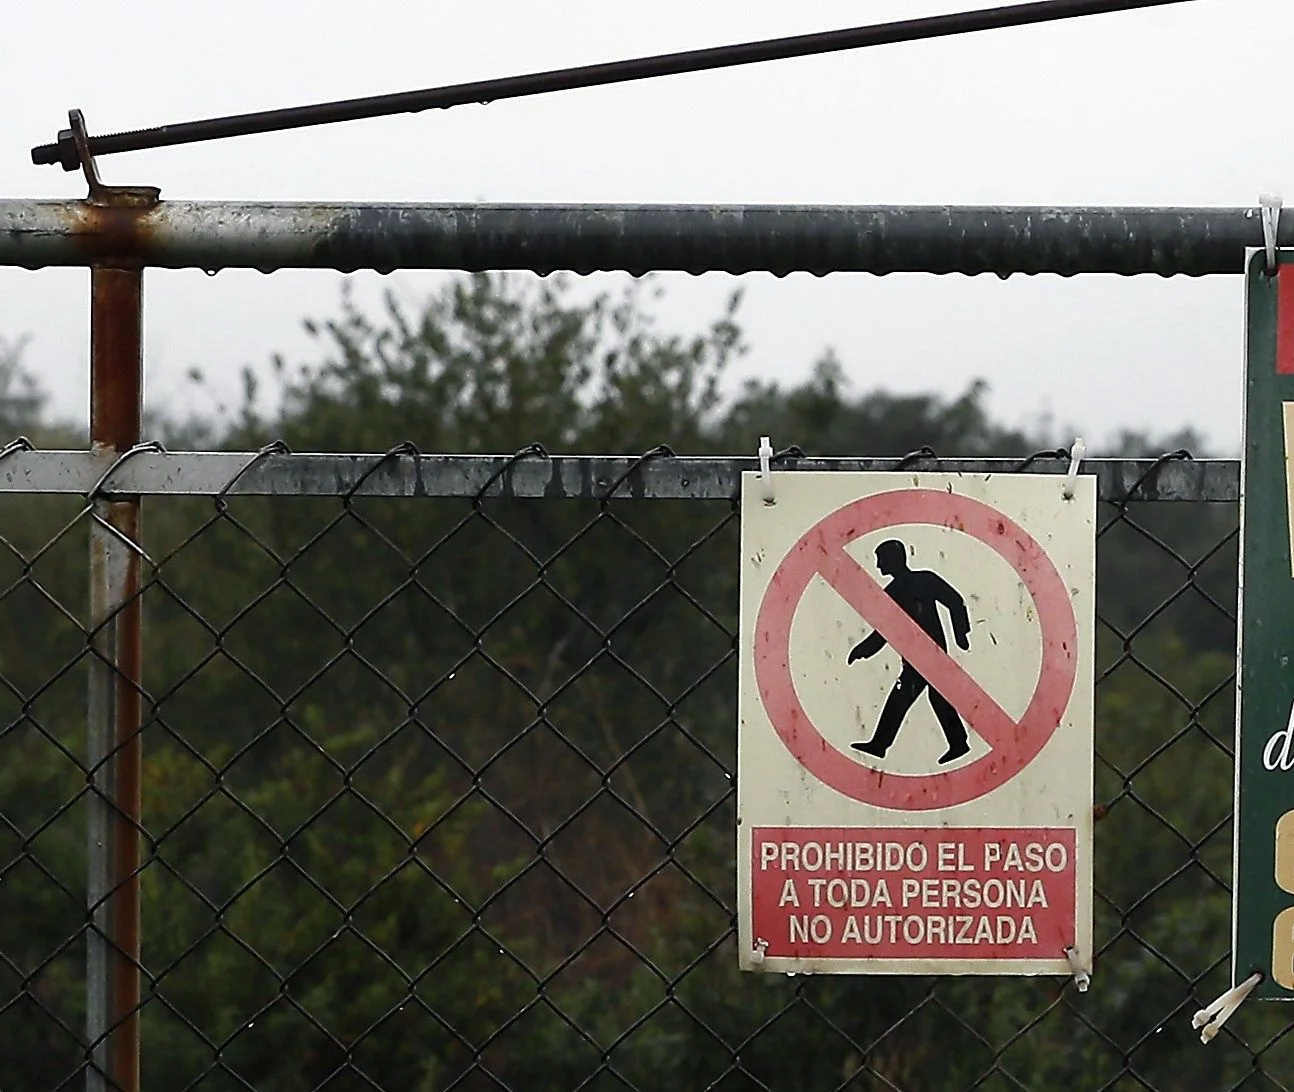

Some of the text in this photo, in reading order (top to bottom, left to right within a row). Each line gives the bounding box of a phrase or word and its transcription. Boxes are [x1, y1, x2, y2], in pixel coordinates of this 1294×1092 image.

[760, 842, 1068, 874] PROHIBIDO EL PASO
[779, 878, 1049, 909] A TODA PERSONA
[789, 915, 1038, 945] NO AUTORIZADA
